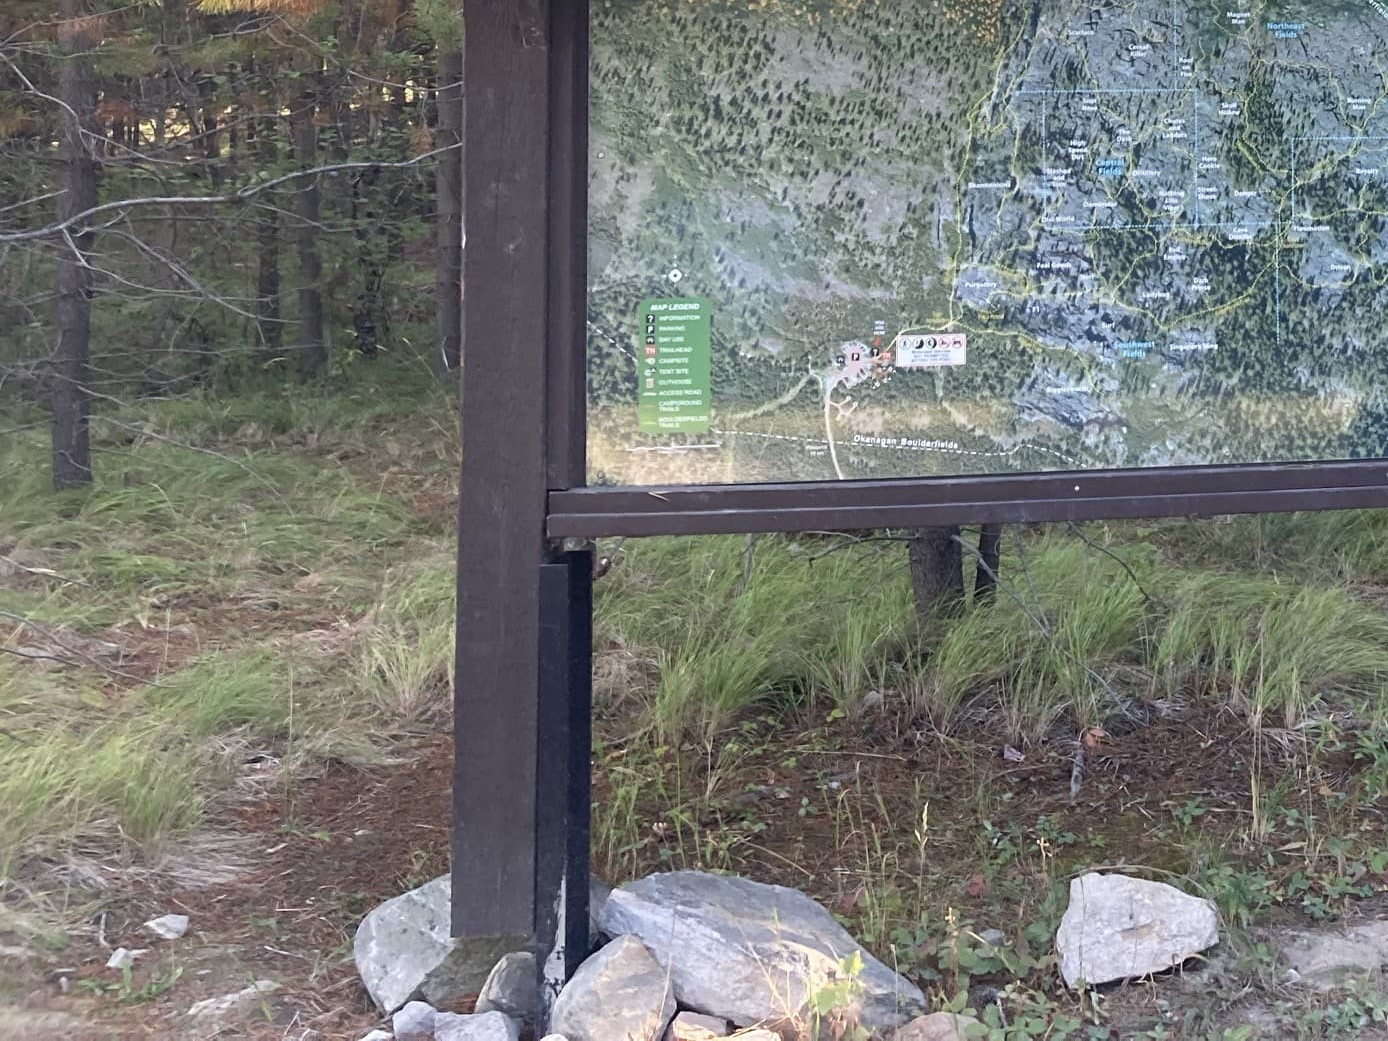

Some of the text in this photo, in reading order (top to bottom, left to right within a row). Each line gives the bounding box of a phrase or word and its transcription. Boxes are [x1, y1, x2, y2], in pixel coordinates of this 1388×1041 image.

[1267, 22, 1305, 30] Northeast
[1275, 31, 1298, 39] Fields
[1095, 158, 1125, 167] Central
[1099, 167, 1122, 175] Fields
[650, 303, 700, 311] MAP LEGEND
[1113, 340, 1155, 349] Southwest
[1122, 349, 1147, 358] Fields
[853, 434, 959, 449] Okanagan Boulderfields
